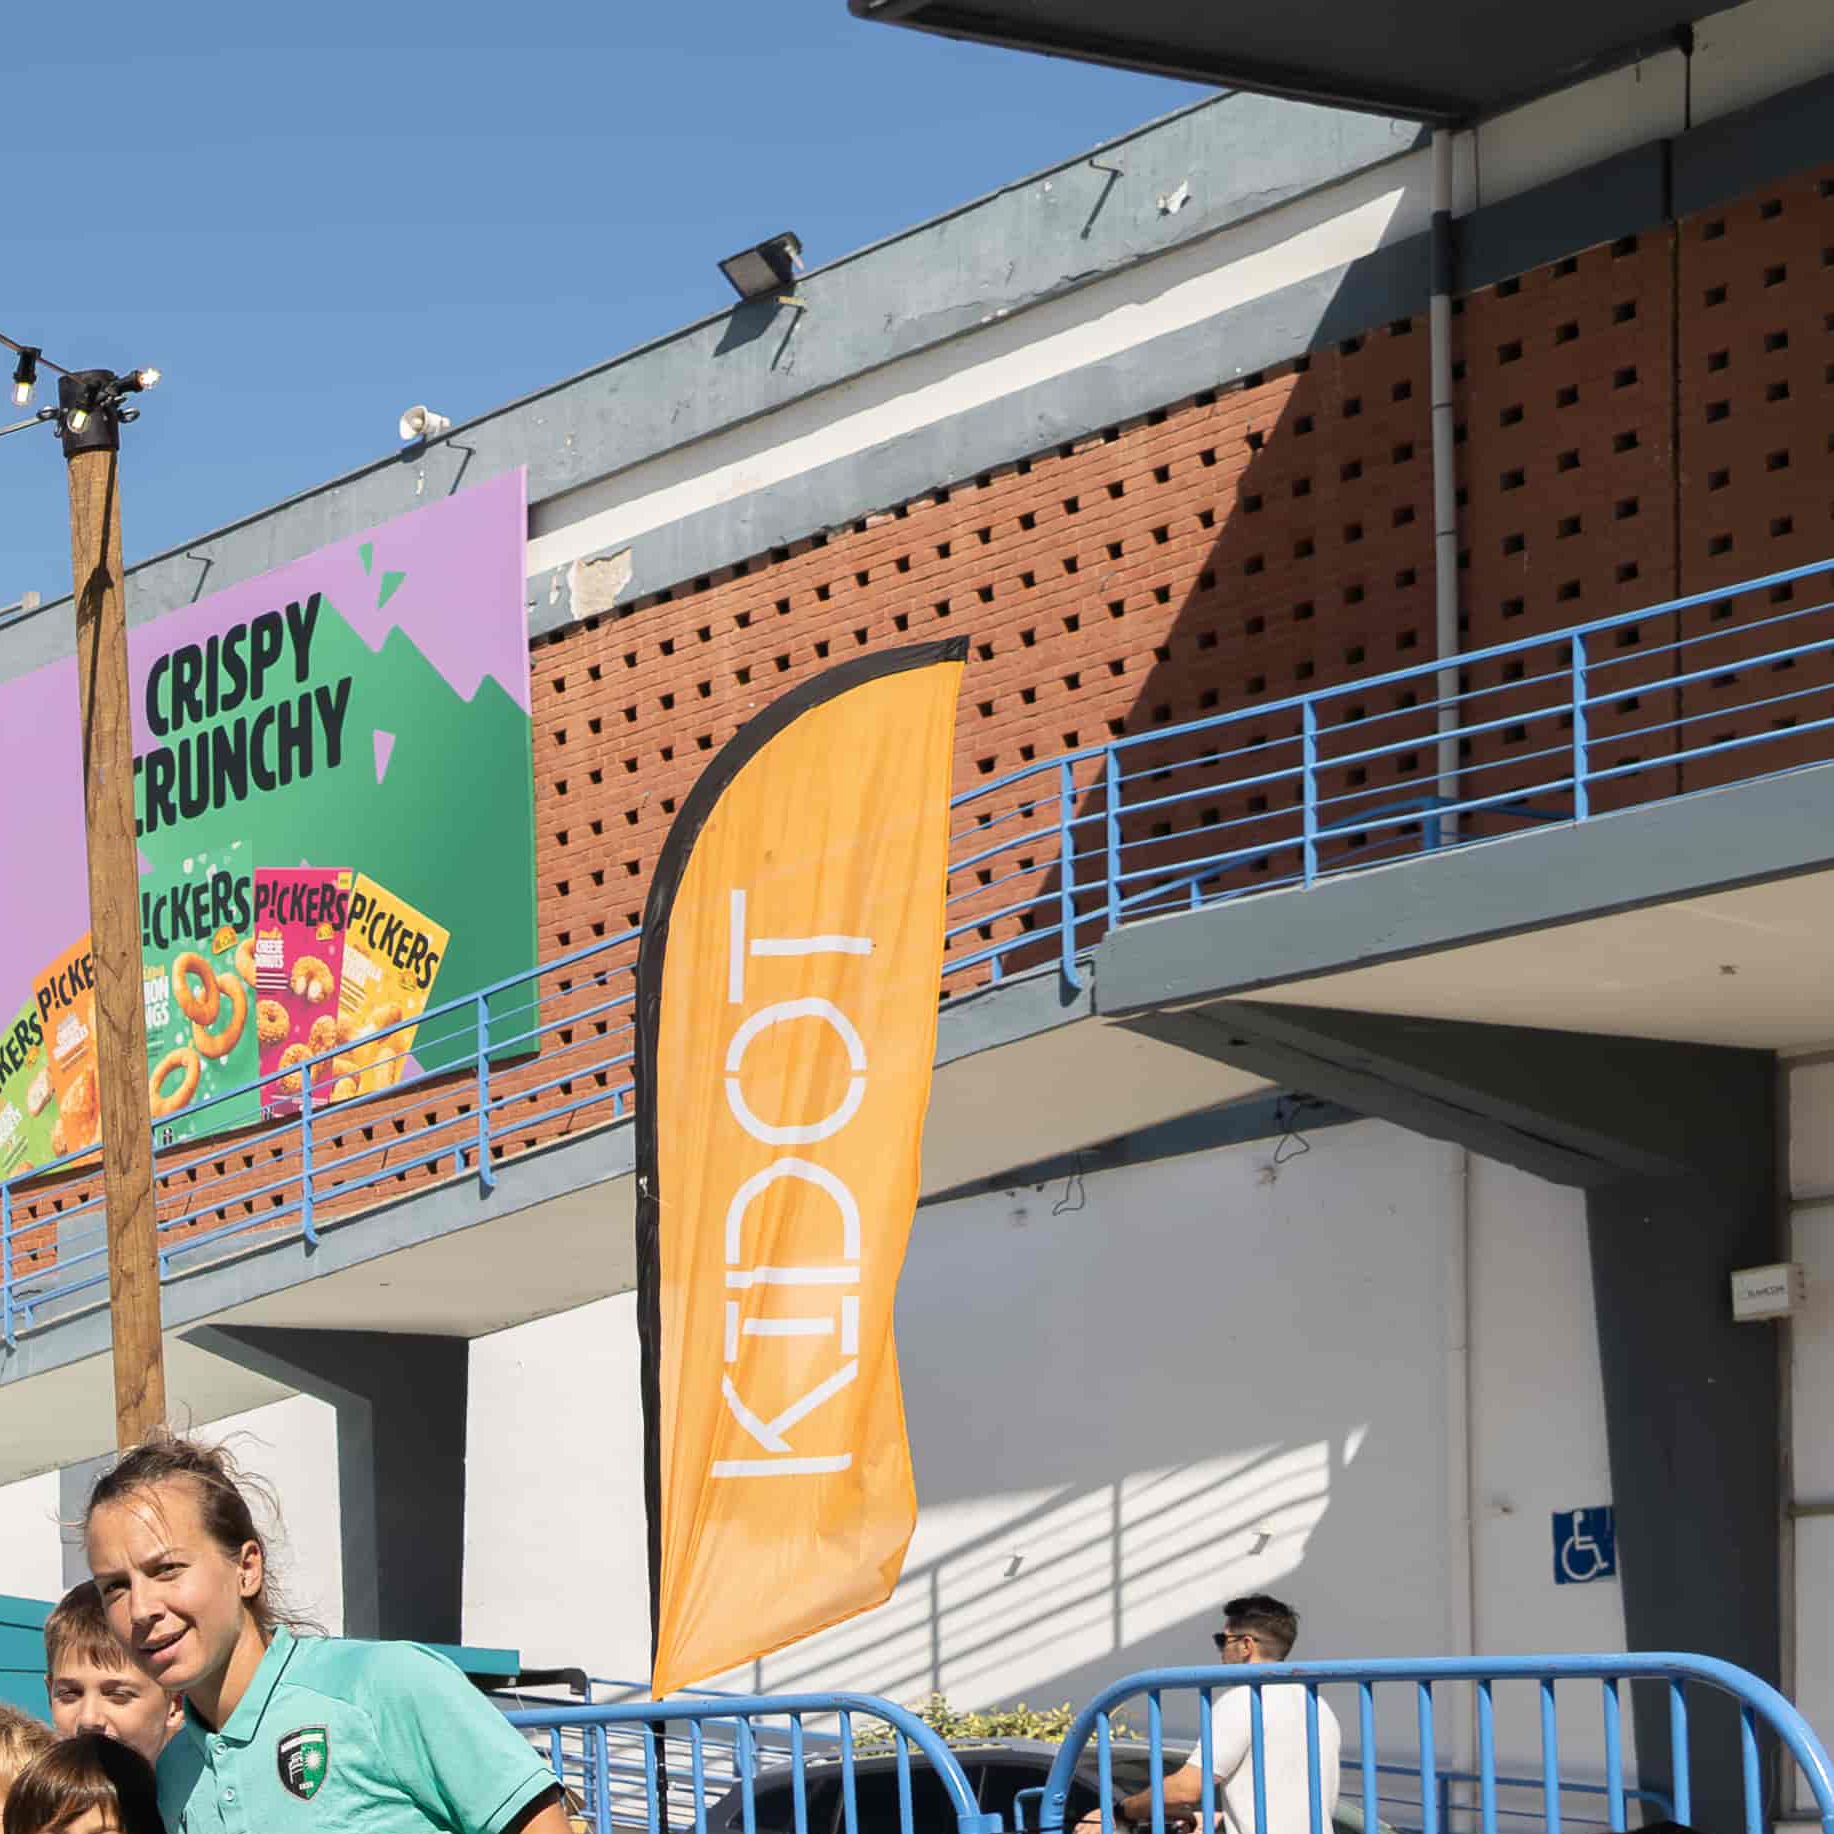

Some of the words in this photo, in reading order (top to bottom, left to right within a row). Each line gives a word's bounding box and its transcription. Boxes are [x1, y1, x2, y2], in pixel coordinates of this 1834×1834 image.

[146, 592, 321, 736] CRISPY
[141, 871, 250, 949] !CKERS
[36, 951, 94, 1023] P!CKE
[711, 888, 873, 1478] KIDOT
